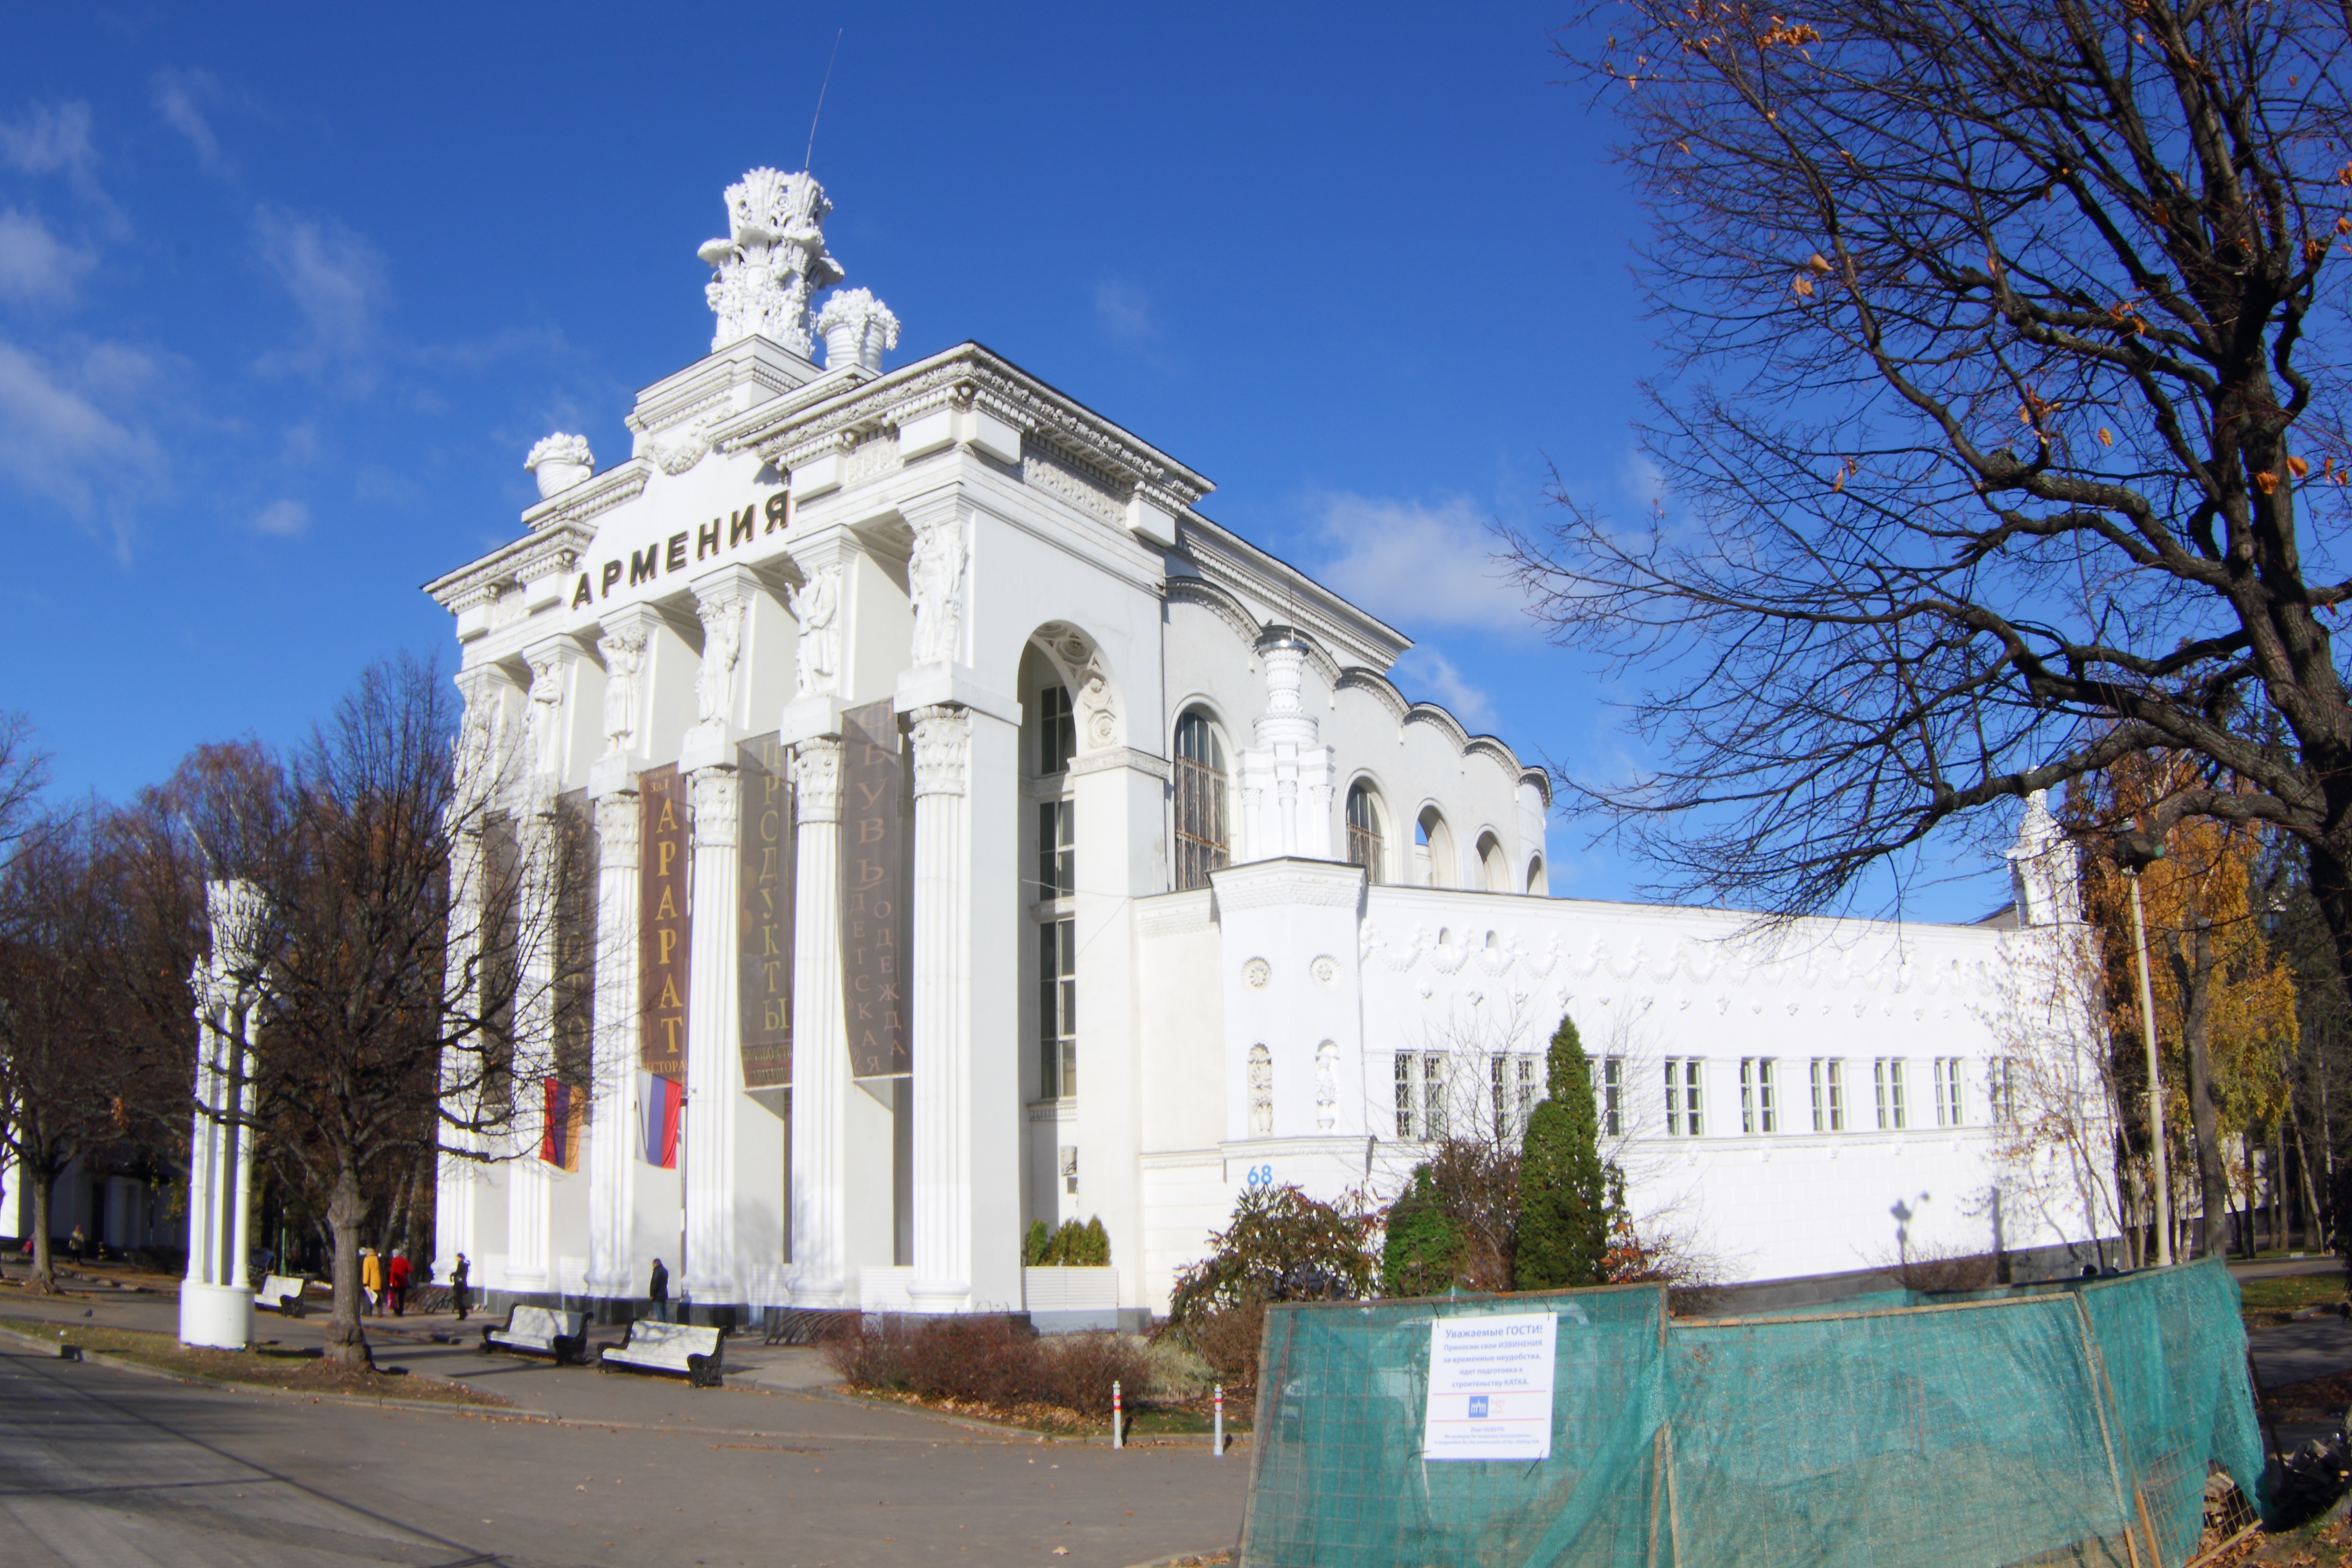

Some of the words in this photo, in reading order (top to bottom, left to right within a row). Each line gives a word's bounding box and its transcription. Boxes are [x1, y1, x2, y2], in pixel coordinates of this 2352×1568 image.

[572, 490, 791, 610] АРМЕНИЯ
[856, 704, 892, 884] ОБУВЬ
[656, 797, 683, 1054] АРАРАТ
[758, 738, 790, 1032] ПРОДУКТЫ
[849, 893, 881, 1072] ДЕТСКАЯ
[874, 900, 906, 1057] ОДЕЖДА
[1247, 1165, 1273, 1185] 68
[1446, 1329, 1504, 1339] Уважаемые
[1506, 1325, 1542, 1335] ГОСТИ!
[1497, 1353, 1541, 1361] неудобства,
[1499, 1340, 1542, 1348] ИЗВИНЕНИЯ
